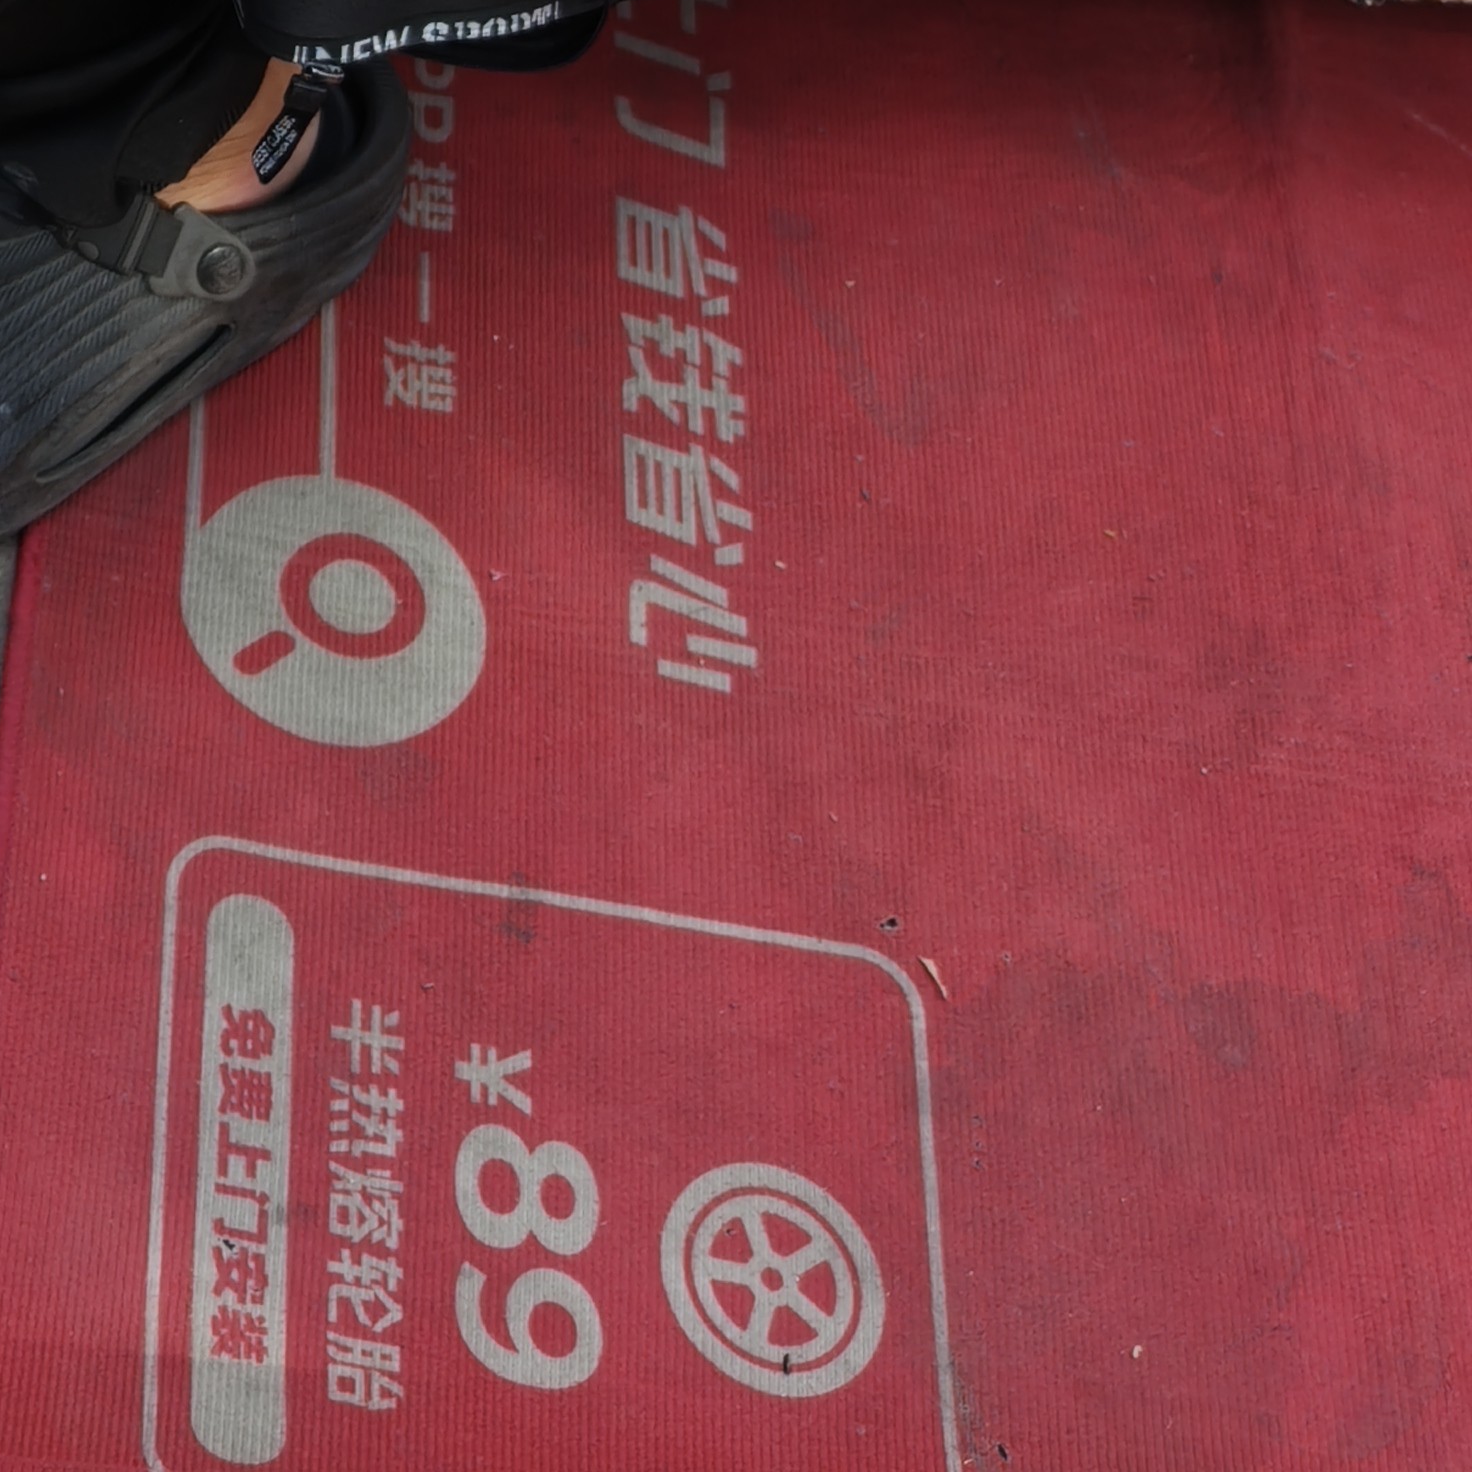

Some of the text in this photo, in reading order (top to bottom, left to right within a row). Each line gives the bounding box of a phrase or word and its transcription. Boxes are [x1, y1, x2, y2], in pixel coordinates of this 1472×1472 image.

[613, 195, 759, 695] 省钱省心
[208, 1000, 275, 1364] 免费上门安装
[325, 995, 406, 1413] 半热熔轮胎
[454, 1040, 604, 1391] ¥89
